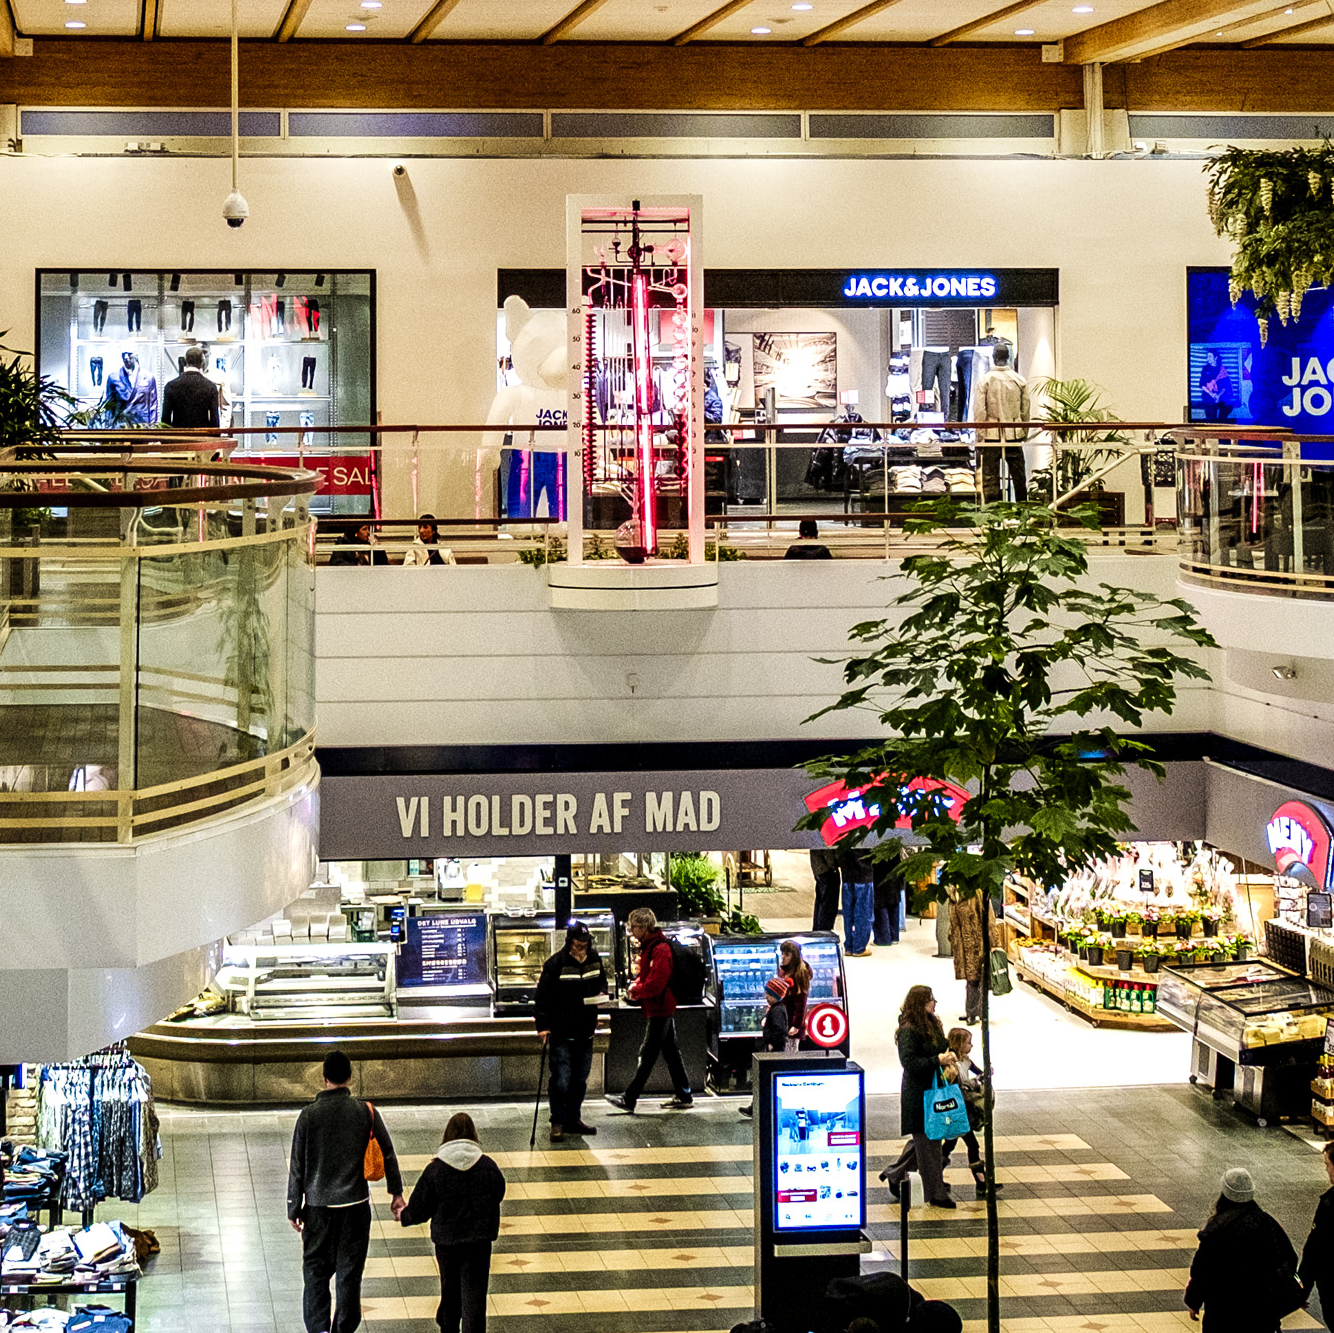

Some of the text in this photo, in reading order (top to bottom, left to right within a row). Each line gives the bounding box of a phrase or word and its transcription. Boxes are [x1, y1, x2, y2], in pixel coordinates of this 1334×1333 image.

[844, 277, 996, 297] JACK&JONES
[396, 790, 721, 838] VI HOLDER AF MAD
